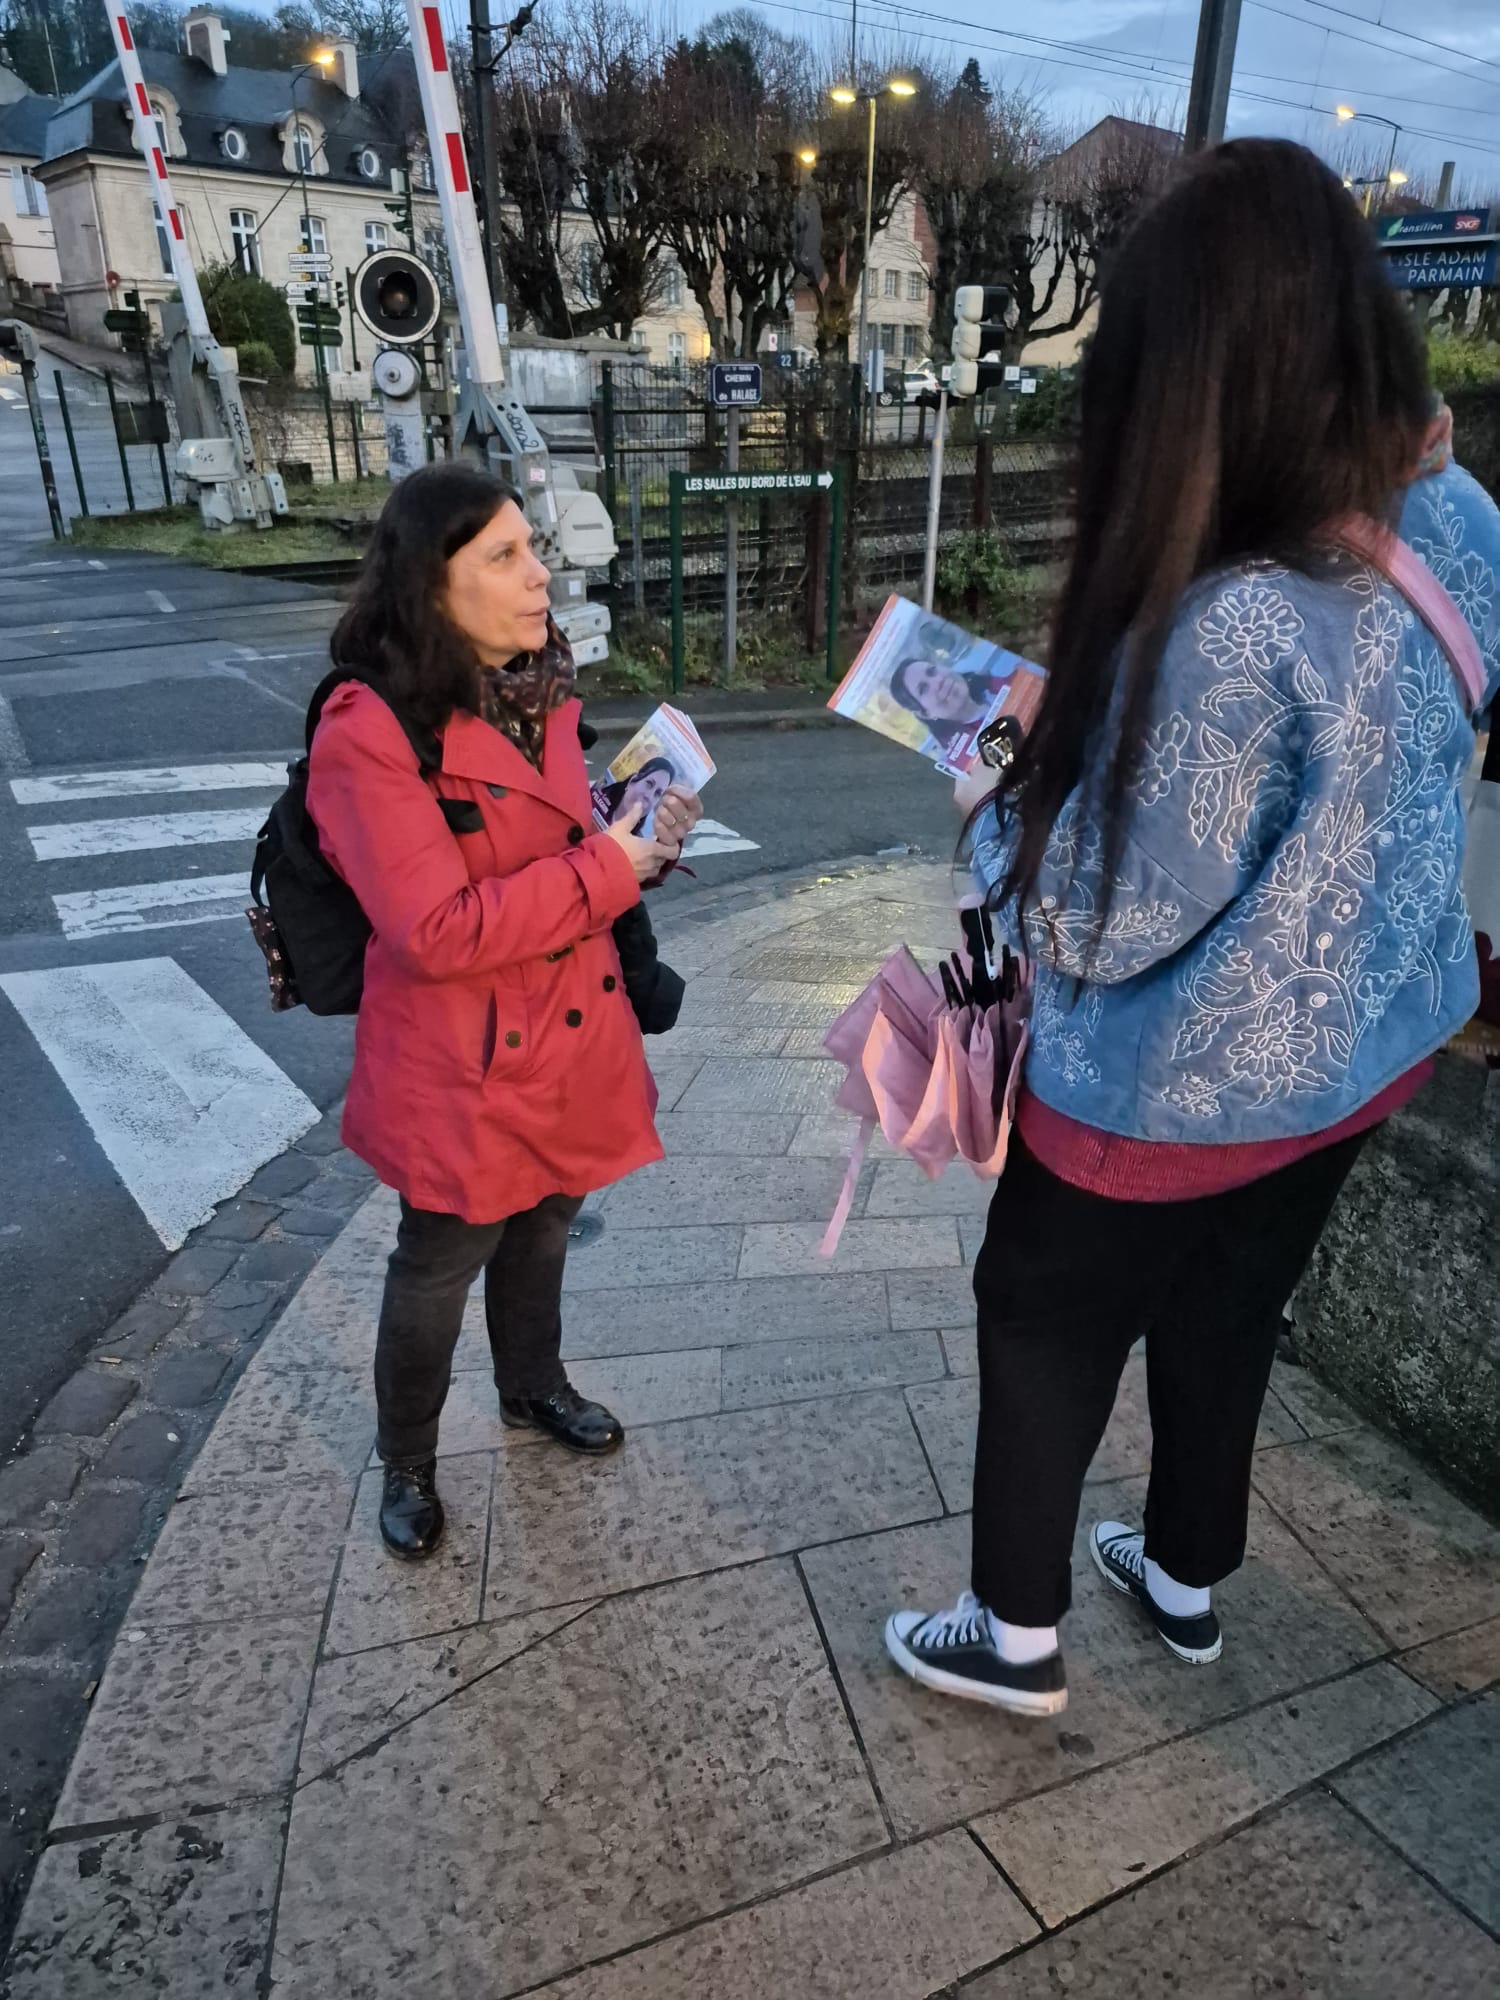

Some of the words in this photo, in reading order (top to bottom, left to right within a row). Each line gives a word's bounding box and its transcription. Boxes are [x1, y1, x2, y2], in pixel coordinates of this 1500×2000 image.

[1455, 220, 1480, 230] SNCF
[1437, 250, 1487, 265] ADAM
[1408, 266, 1484, 283] PARMAIN
[780, 354, 792, 367] 22
[724, 374, 752, 383] CHEMIN
[731, 389, 757, 400] HALAGE
[685, 478, 703, 491] LES
[703, 477, 737, 490] SALLES
[738, 476, 750, 489] DU
[751, 475, 775, 489] BORD
[776, 474, 788, 488] DE
[788, 474, 812, 487] L'EAU
